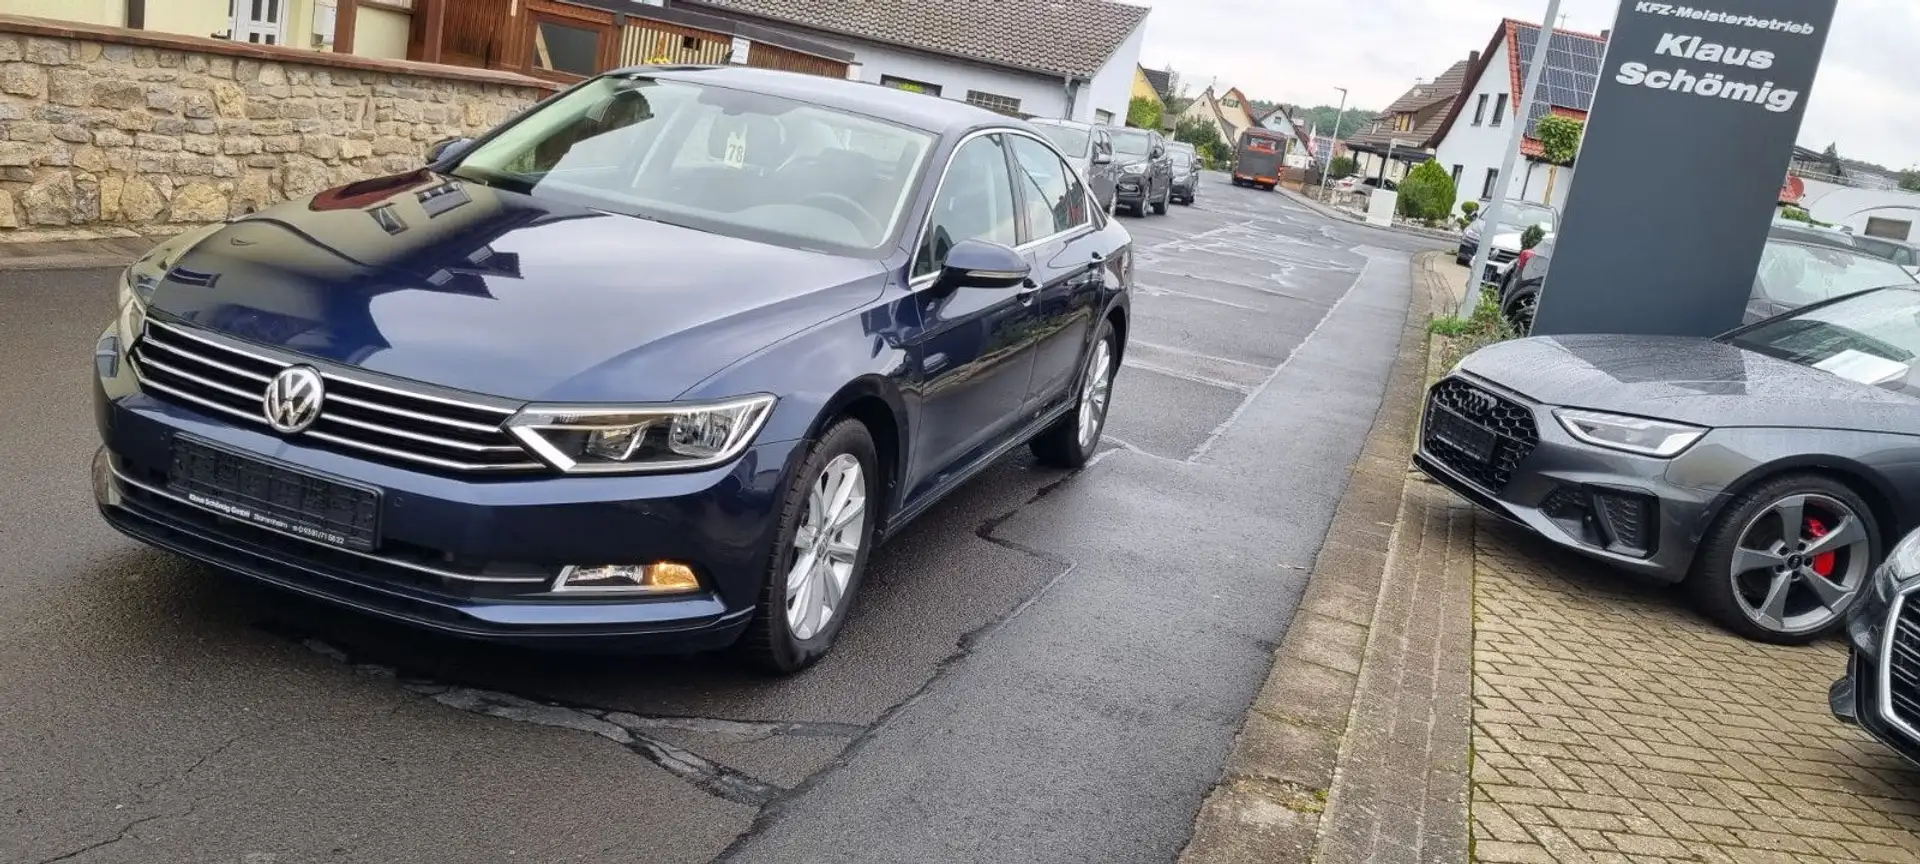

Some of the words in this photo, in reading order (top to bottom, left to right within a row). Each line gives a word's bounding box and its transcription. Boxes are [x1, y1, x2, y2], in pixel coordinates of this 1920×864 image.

[1635, 1, 1814, 35] KFZ-Meisterbetrieb
[1654, 32, 1776, 70] Klaus
[1615, 61, 1798, 113] Schömig
[726, 143, 743, 163] 78
